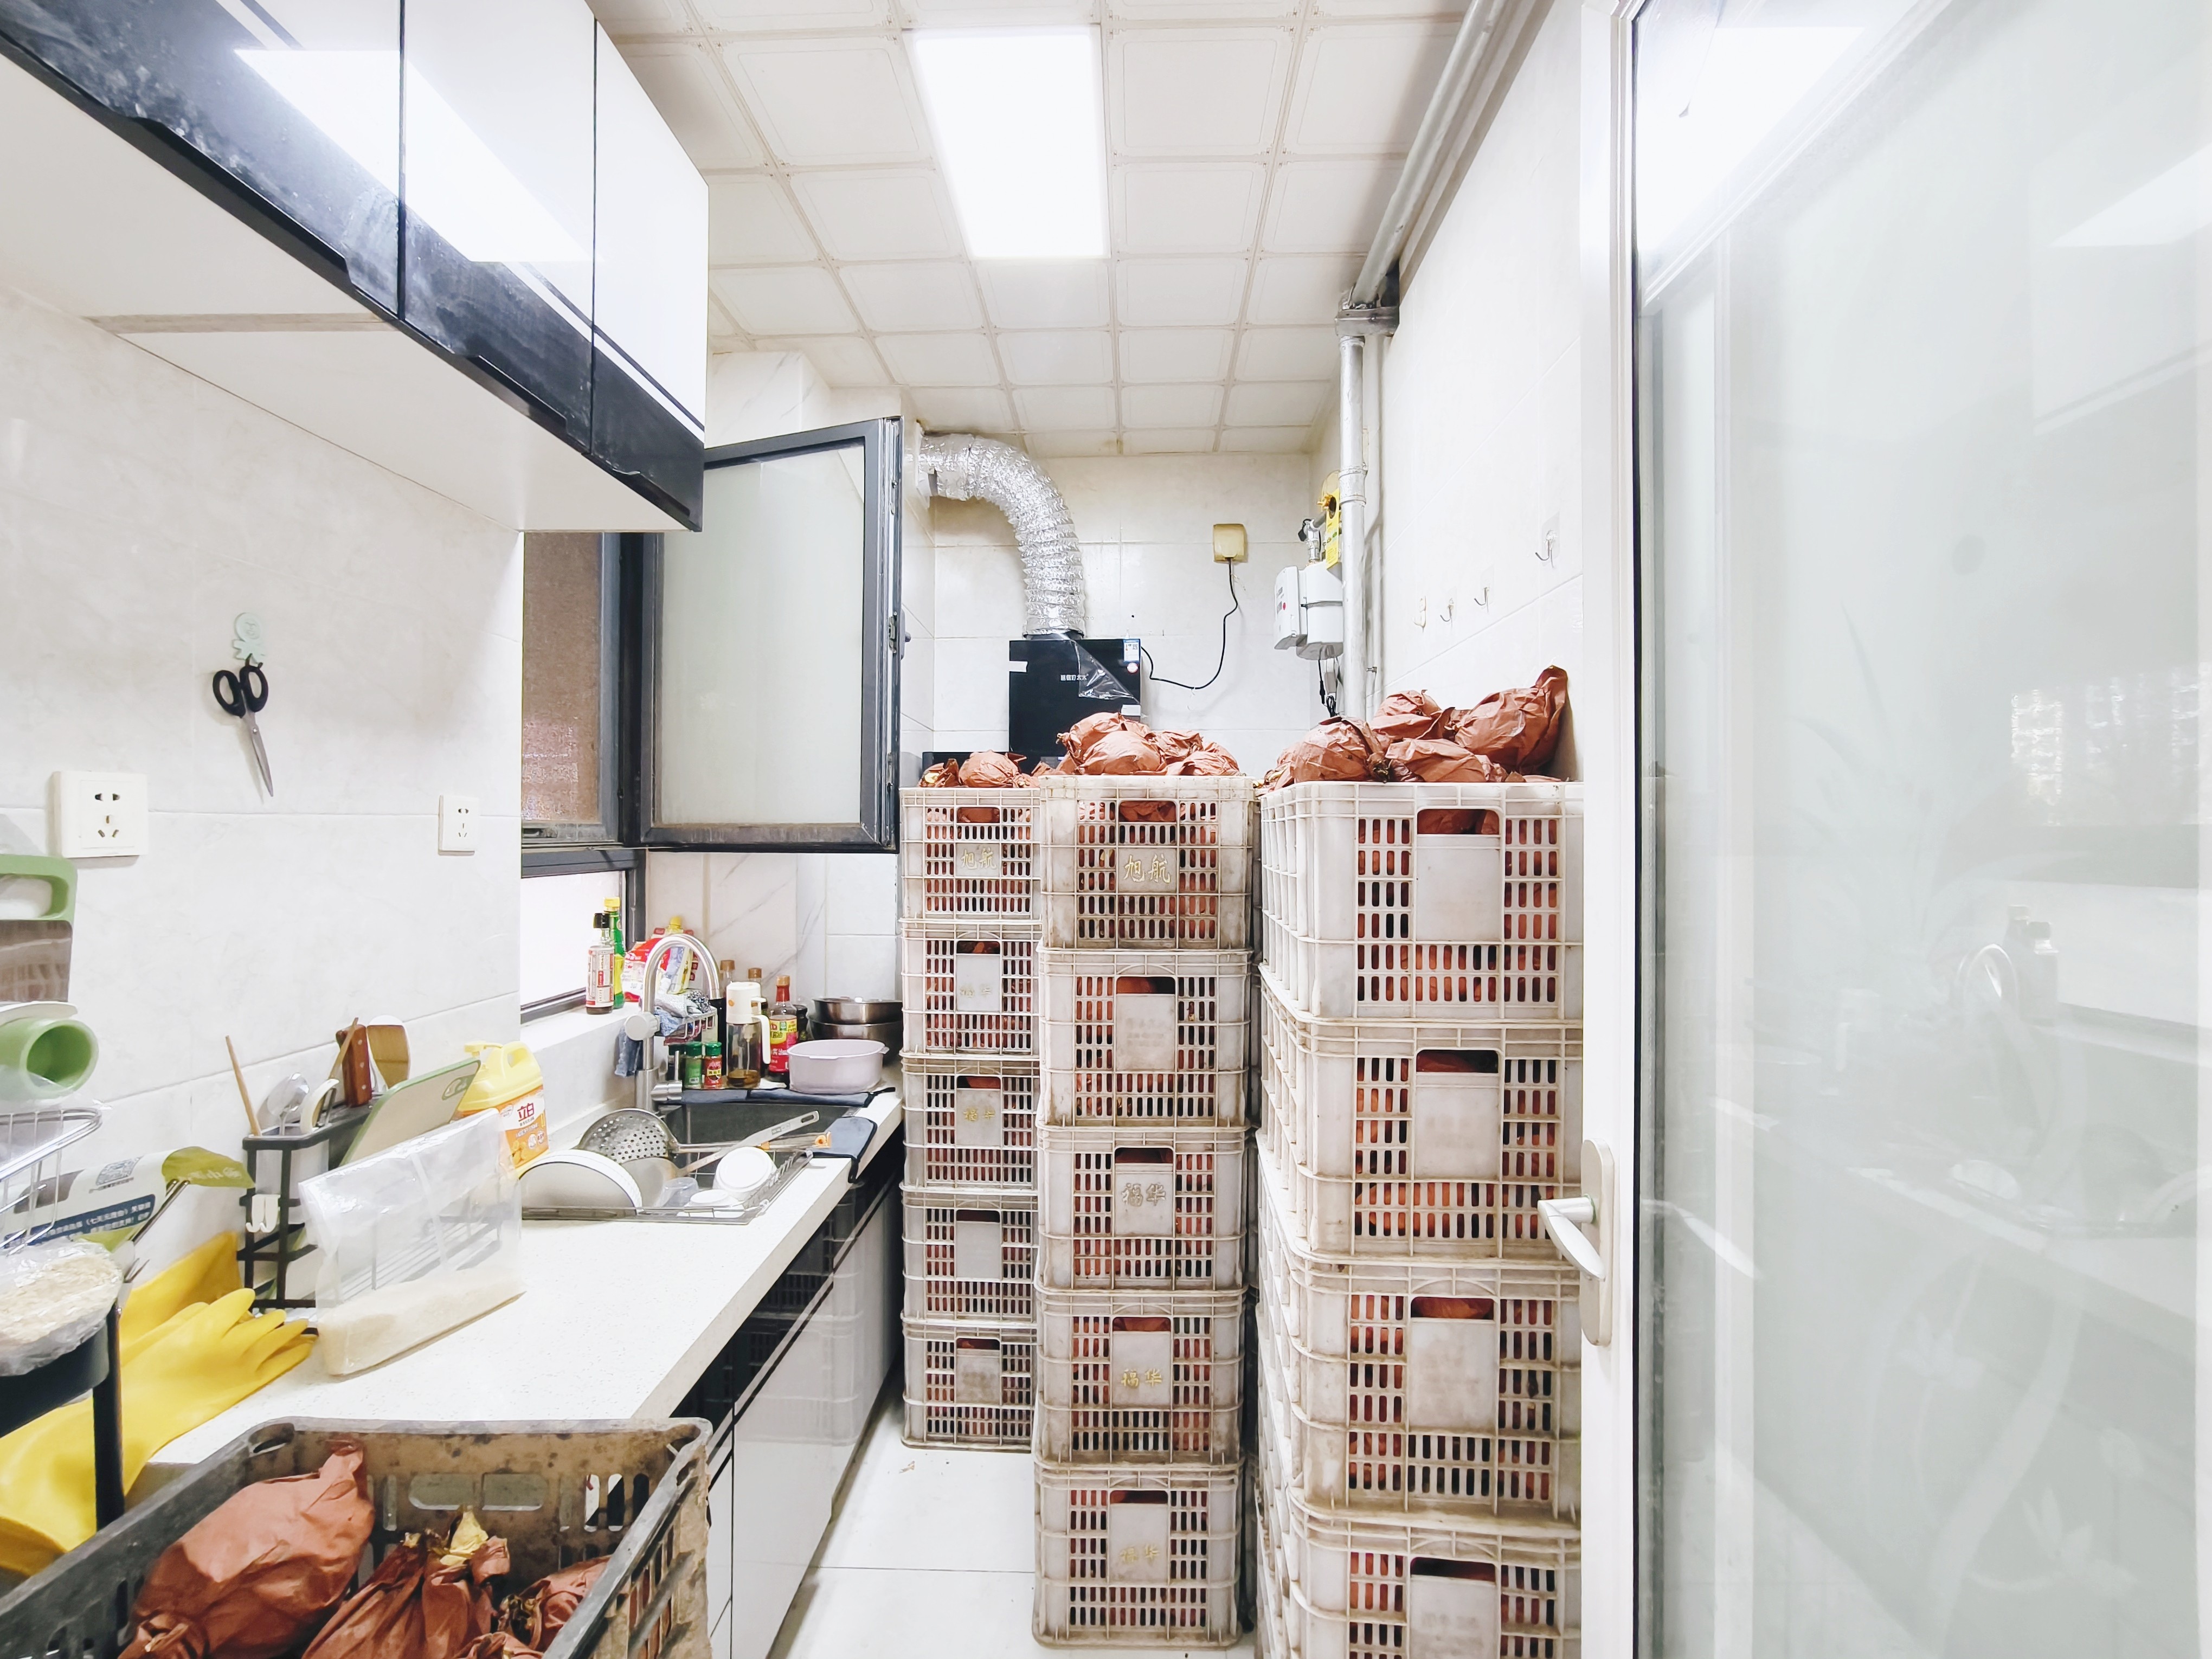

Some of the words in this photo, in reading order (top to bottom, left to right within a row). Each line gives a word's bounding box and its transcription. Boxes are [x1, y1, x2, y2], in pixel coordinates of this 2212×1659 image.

[961, 847, 997, 870] 旭航
[1123, 853, 1171, 884] 旭航
[517, 1102, 535, 1123] 立白
[1121, 1183, 1166, 1207] 福华
[1120, 1367, 1162, 1388] 福华
